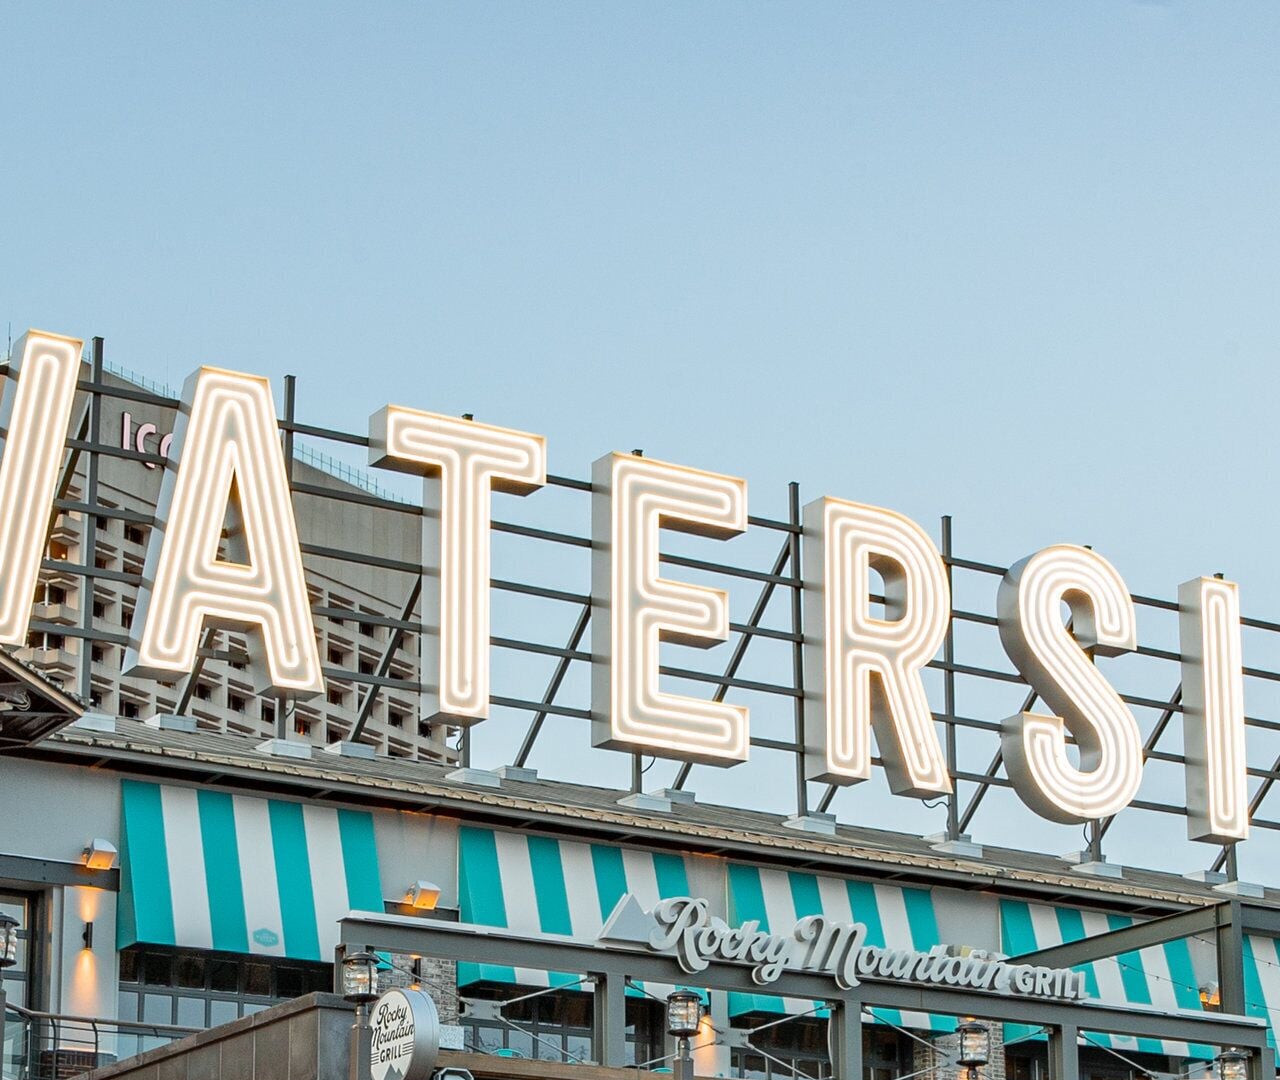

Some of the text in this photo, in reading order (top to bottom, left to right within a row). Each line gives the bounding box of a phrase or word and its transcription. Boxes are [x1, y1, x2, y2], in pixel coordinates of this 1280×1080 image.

[649, 897, 1091, 999] Rocky Mountain GRILL
[377, 1002, 407, 1030] Rocky
[372, 1021, 415, 1051] Mountain
[380, 1044, 401, 1063] GRILL
